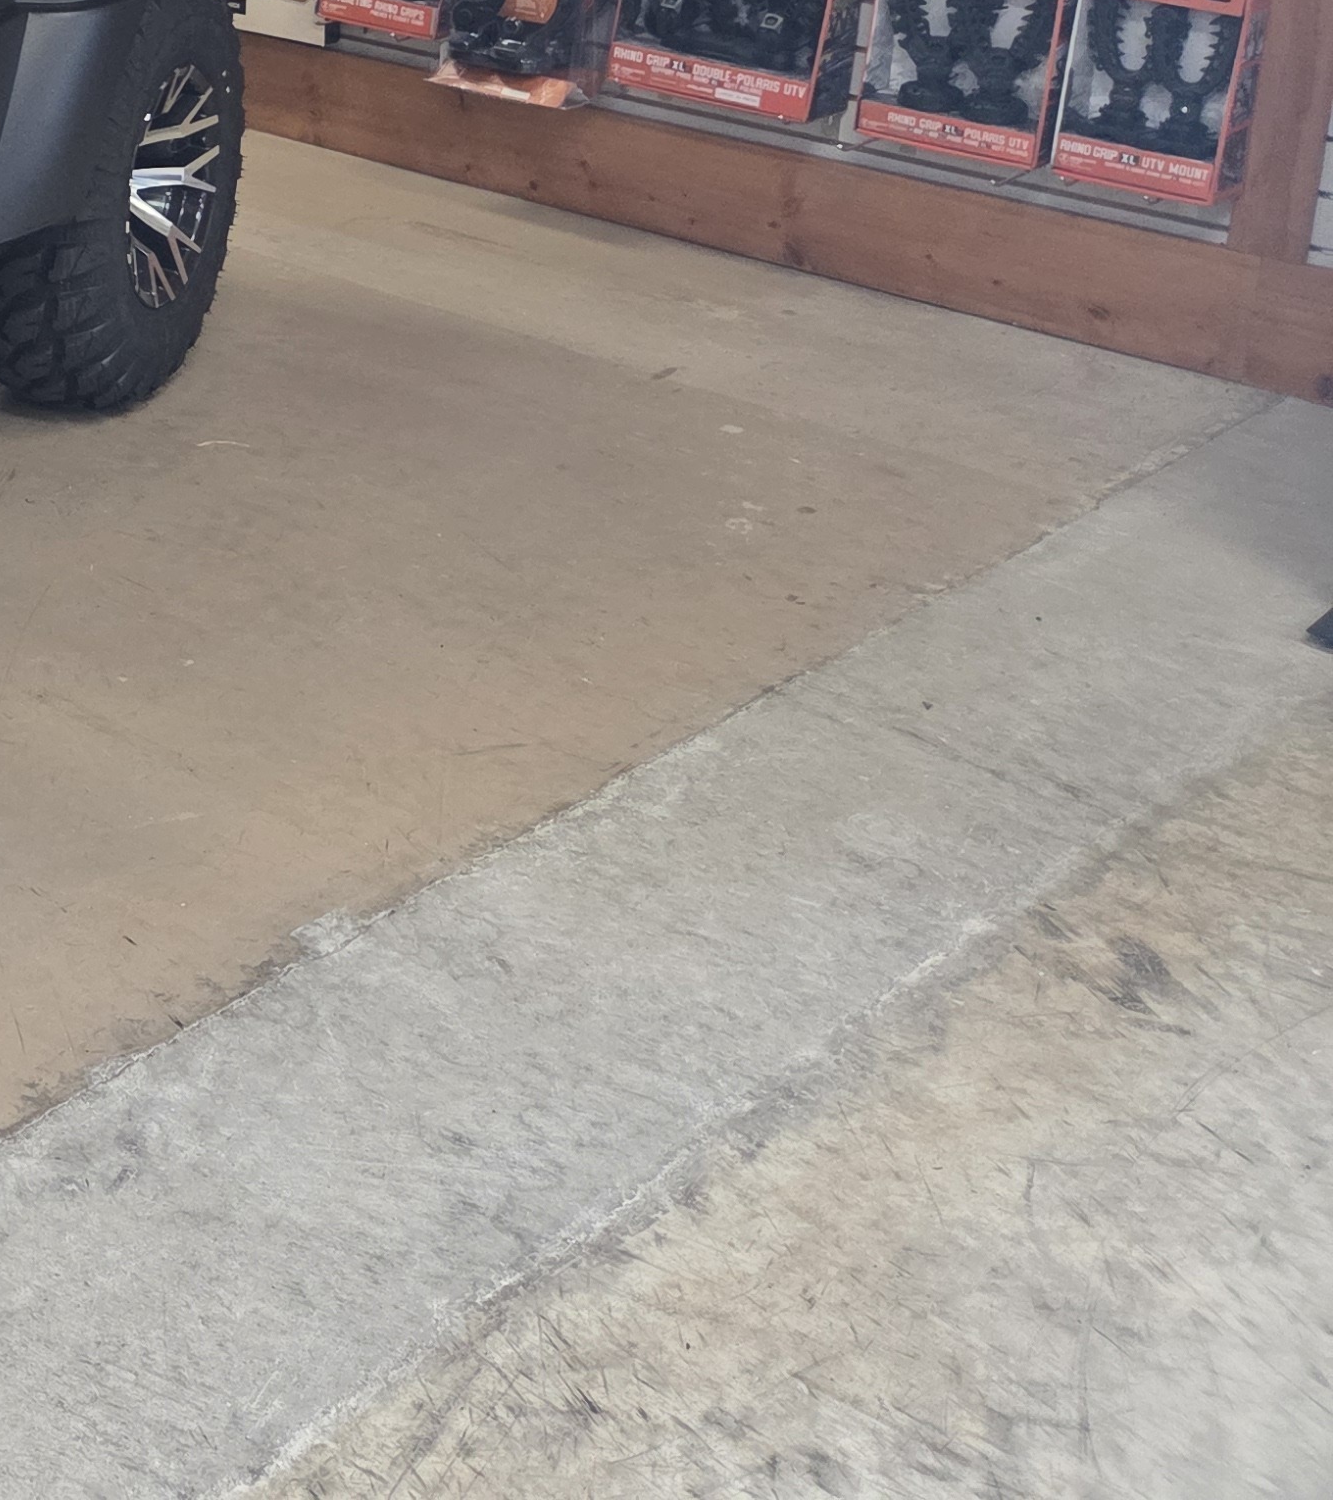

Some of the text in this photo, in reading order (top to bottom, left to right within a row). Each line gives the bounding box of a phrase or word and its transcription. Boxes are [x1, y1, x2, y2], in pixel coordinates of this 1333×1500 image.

[613, 47, 643, 63] RHINO
[646, 54, 670, 68] GRIP
[672, 60, 685, 71] XL
[692, 63, 780, 93] DOUBLE-POLARIS
[784, 84, 806, 99] UTV
[887, 112, 1029, 150] RHINO GRIP XL POLARIS UTV
[1060, 139, 1091, 156] RHINO
[1093, 145, 1118, 160] GRIP
[1120, 152, 1137, 166] XL
[1141, 156, 1166, 172] UTV
[1168, 161, 1209, 182] MOUNT
